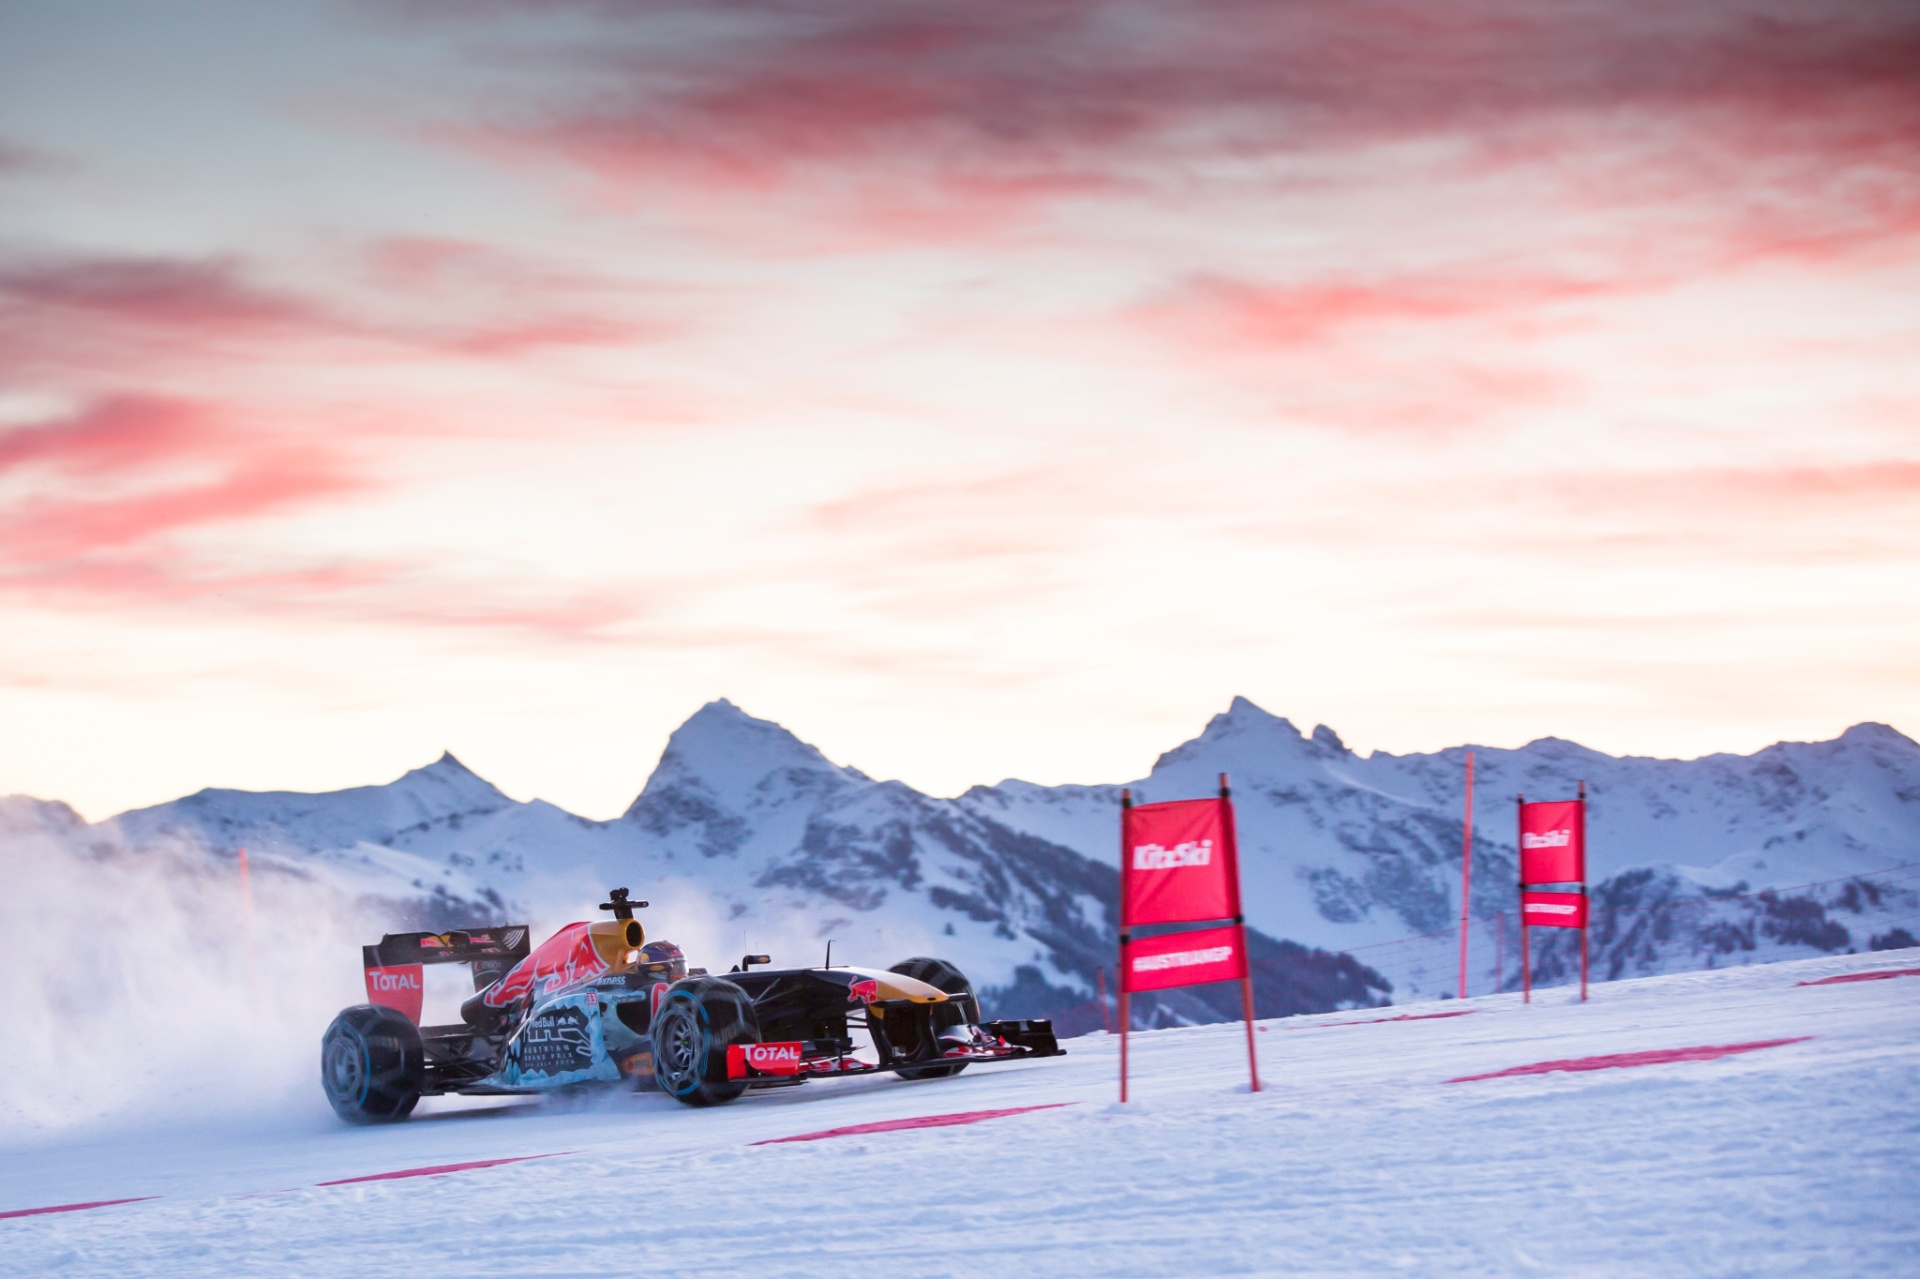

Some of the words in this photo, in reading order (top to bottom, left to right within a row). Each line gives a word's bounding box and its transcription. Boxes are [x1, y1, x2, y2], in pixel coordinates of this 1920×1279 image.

[1132, 839, 1212, 870] KitzSki
[369, 971, 420, 991] TOTAL
[542, 1015, 555, 1028] Bull
[739, 1044, 800, 1061] TOTAL
